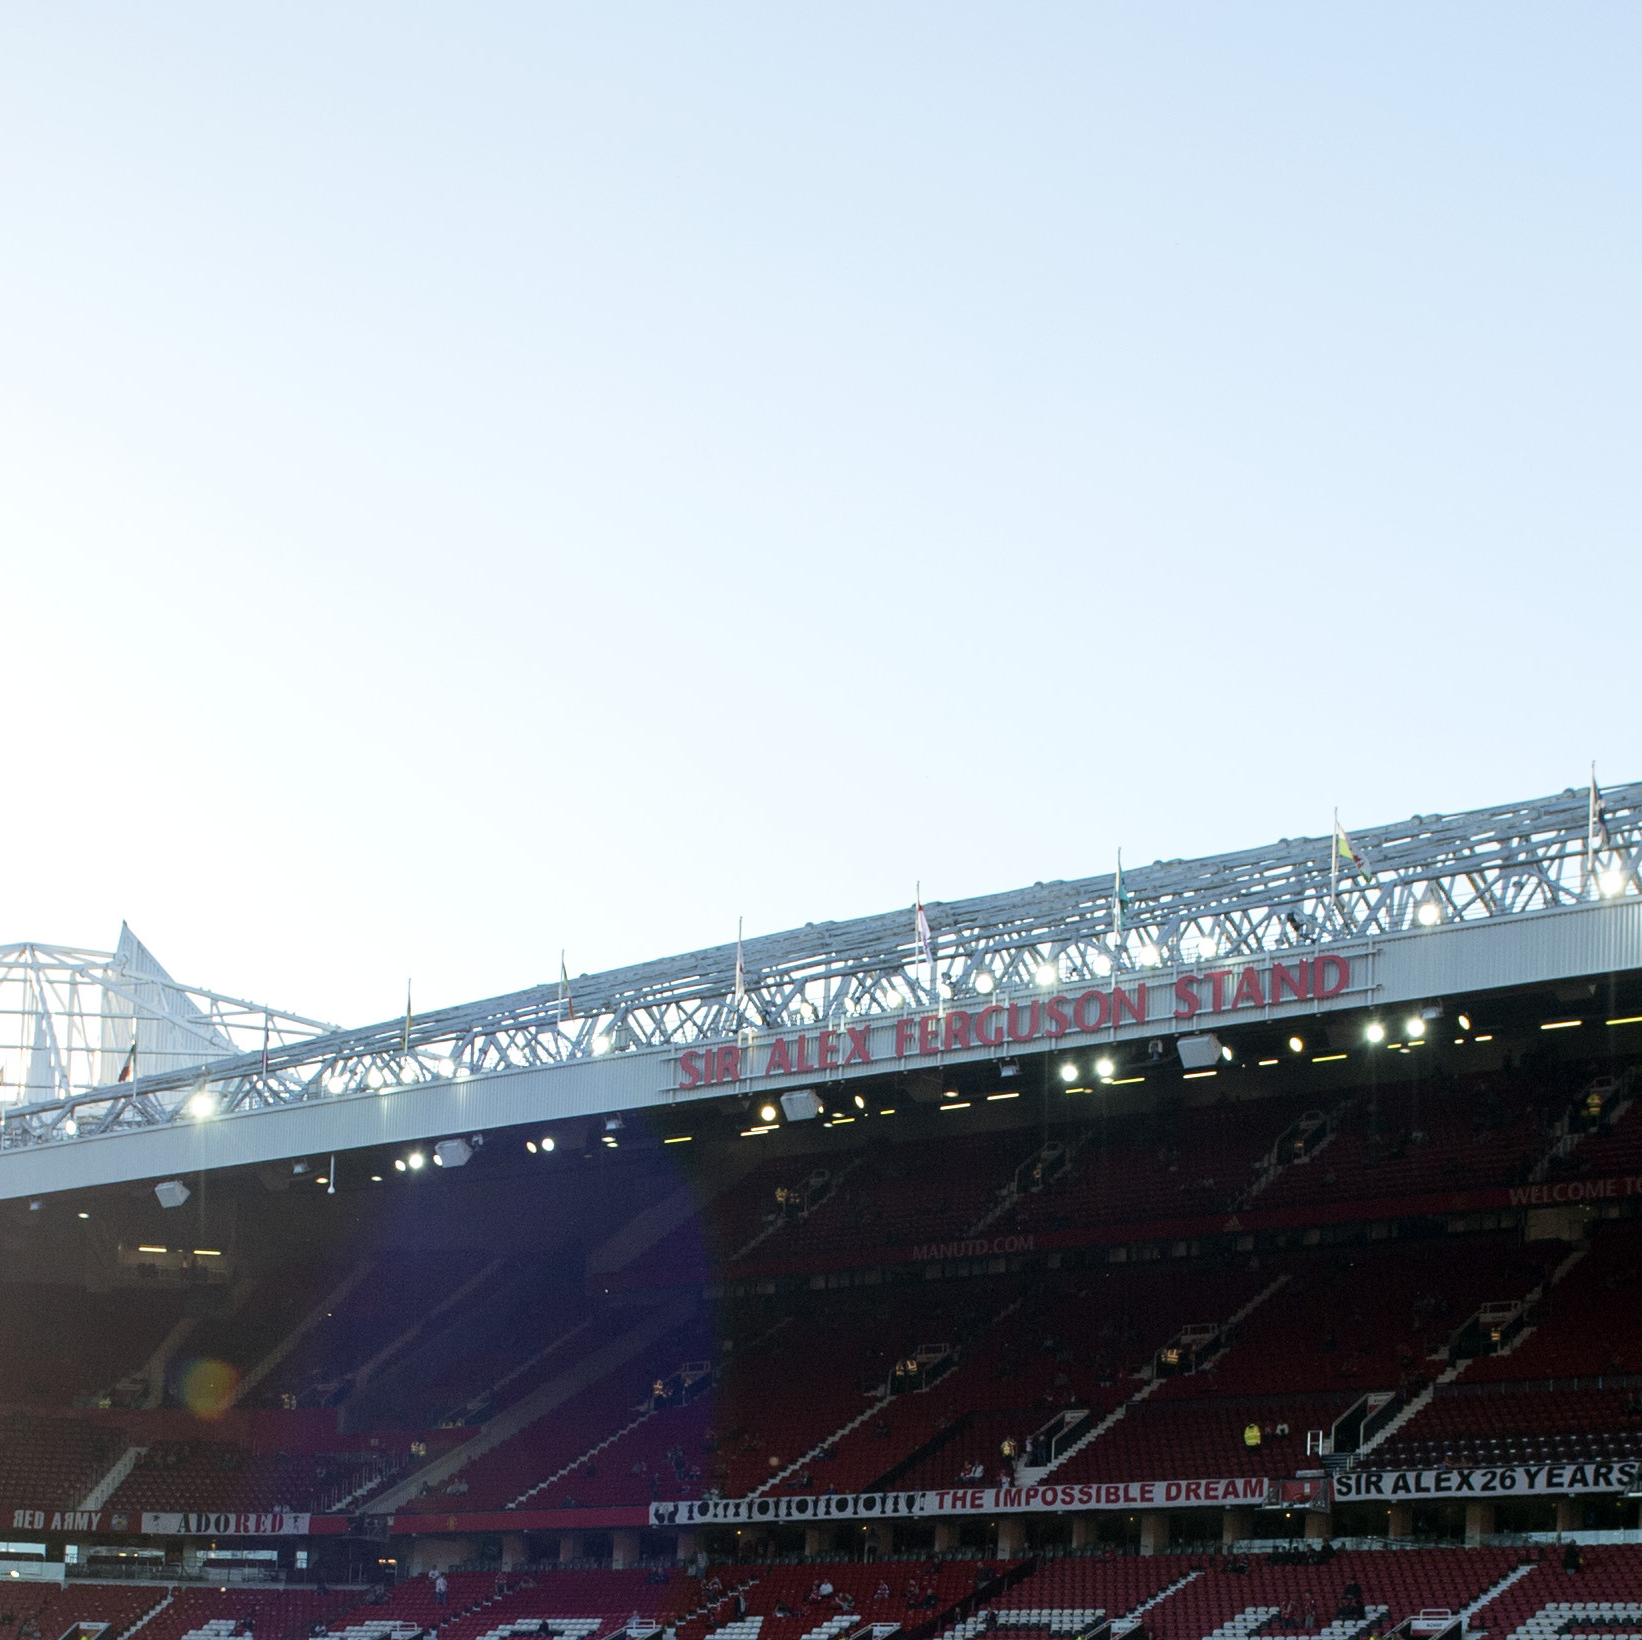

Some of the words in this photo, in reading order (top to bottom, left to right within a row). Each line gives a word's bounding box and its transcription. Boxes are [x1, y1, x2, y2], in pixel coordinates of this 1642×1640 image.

[679, 1045, 740, 1089] SIR
[766, 1024, 872, 1076] ALEX
[896, 983, 1147, 1058] FERGUSON
[1173, 954, 1351, 1018] STAND
[1509, 1178, 1618, 1205] WELCOME
[913, 1235, 1035, 1260] MANUTD.COM
[936, 1489, 985, 1511] THE
[994, 1483, 1155, 1508] IMPOSSIBLE
[1165, 1477, 1265, 1502] DREAM
[1336, 1472, 1384, 1497] SIR
[1390, 1469, 1477, 1495] ALEX
[1479, 1467, 1518, 1492] 26
[1522, 1463, 1638, 1489] YEARS
[176, 1512, 285, 1534] ADORED
